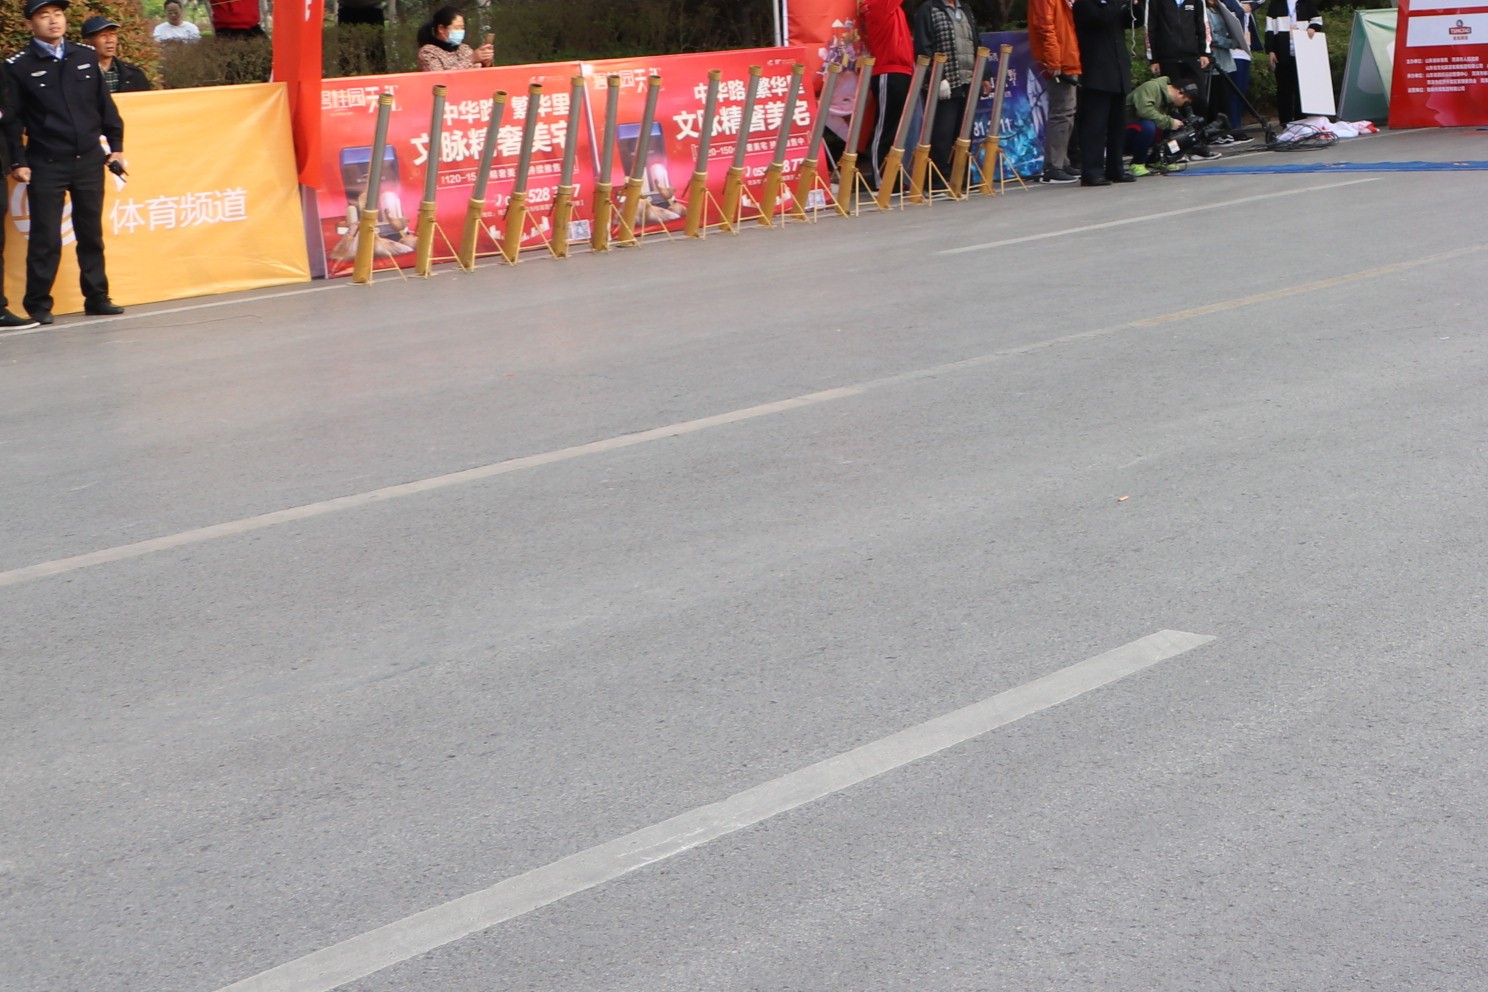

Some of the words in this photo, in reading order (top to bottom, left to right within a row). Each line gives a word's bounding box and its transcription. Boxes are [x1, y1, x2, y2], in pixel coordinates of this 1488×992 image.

[443, 98, 495, 126] 中华路
[109, 186, 248, 235] 体育频道
